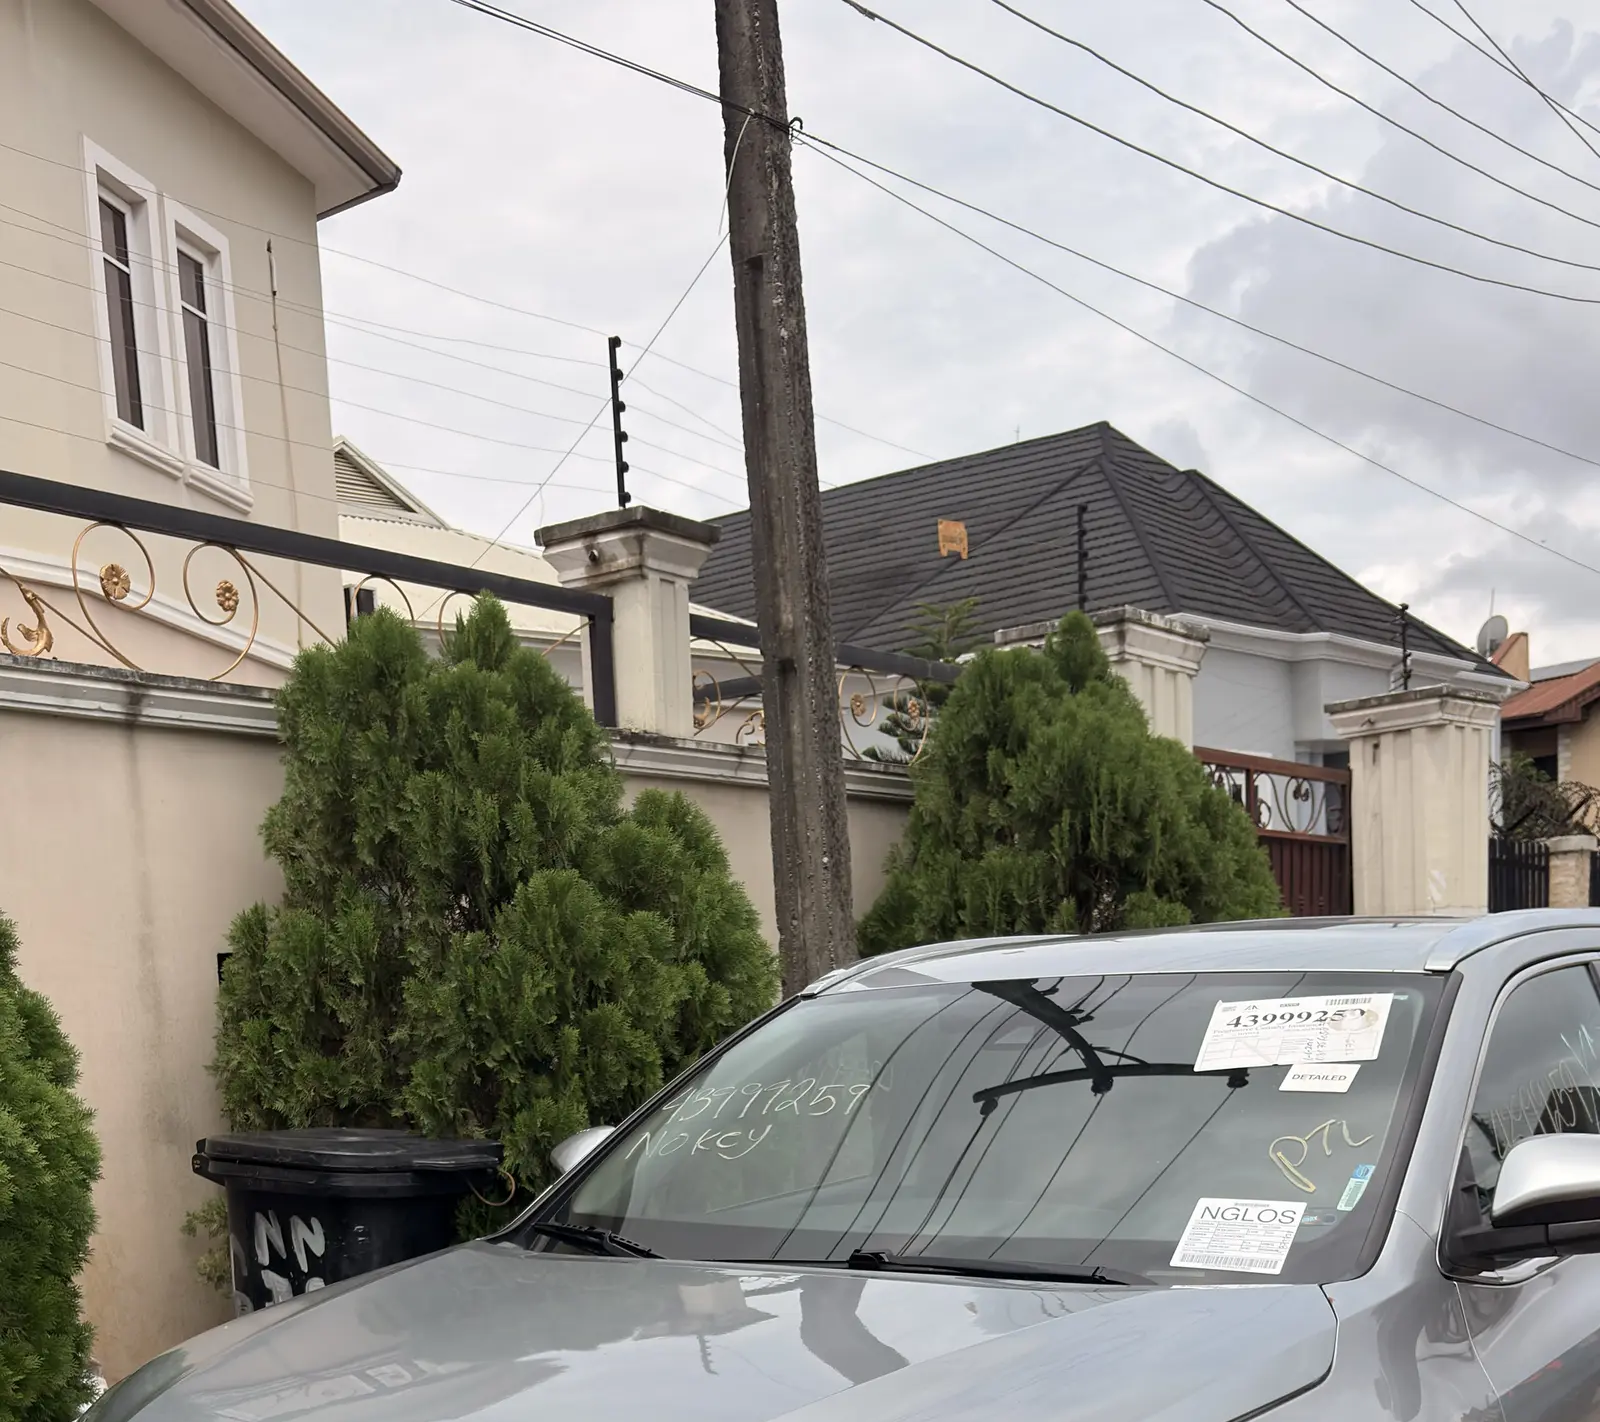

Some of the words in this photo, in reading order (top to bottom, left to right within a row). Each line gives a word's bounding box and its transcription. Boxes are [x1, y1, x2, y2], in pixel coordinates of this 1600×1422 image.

[1291, 1073, 1348, 1082] DETAILED
[661, 1077, 871, 1125] 43999259
[1200, 1206, 1297, 1225] NGLOS
